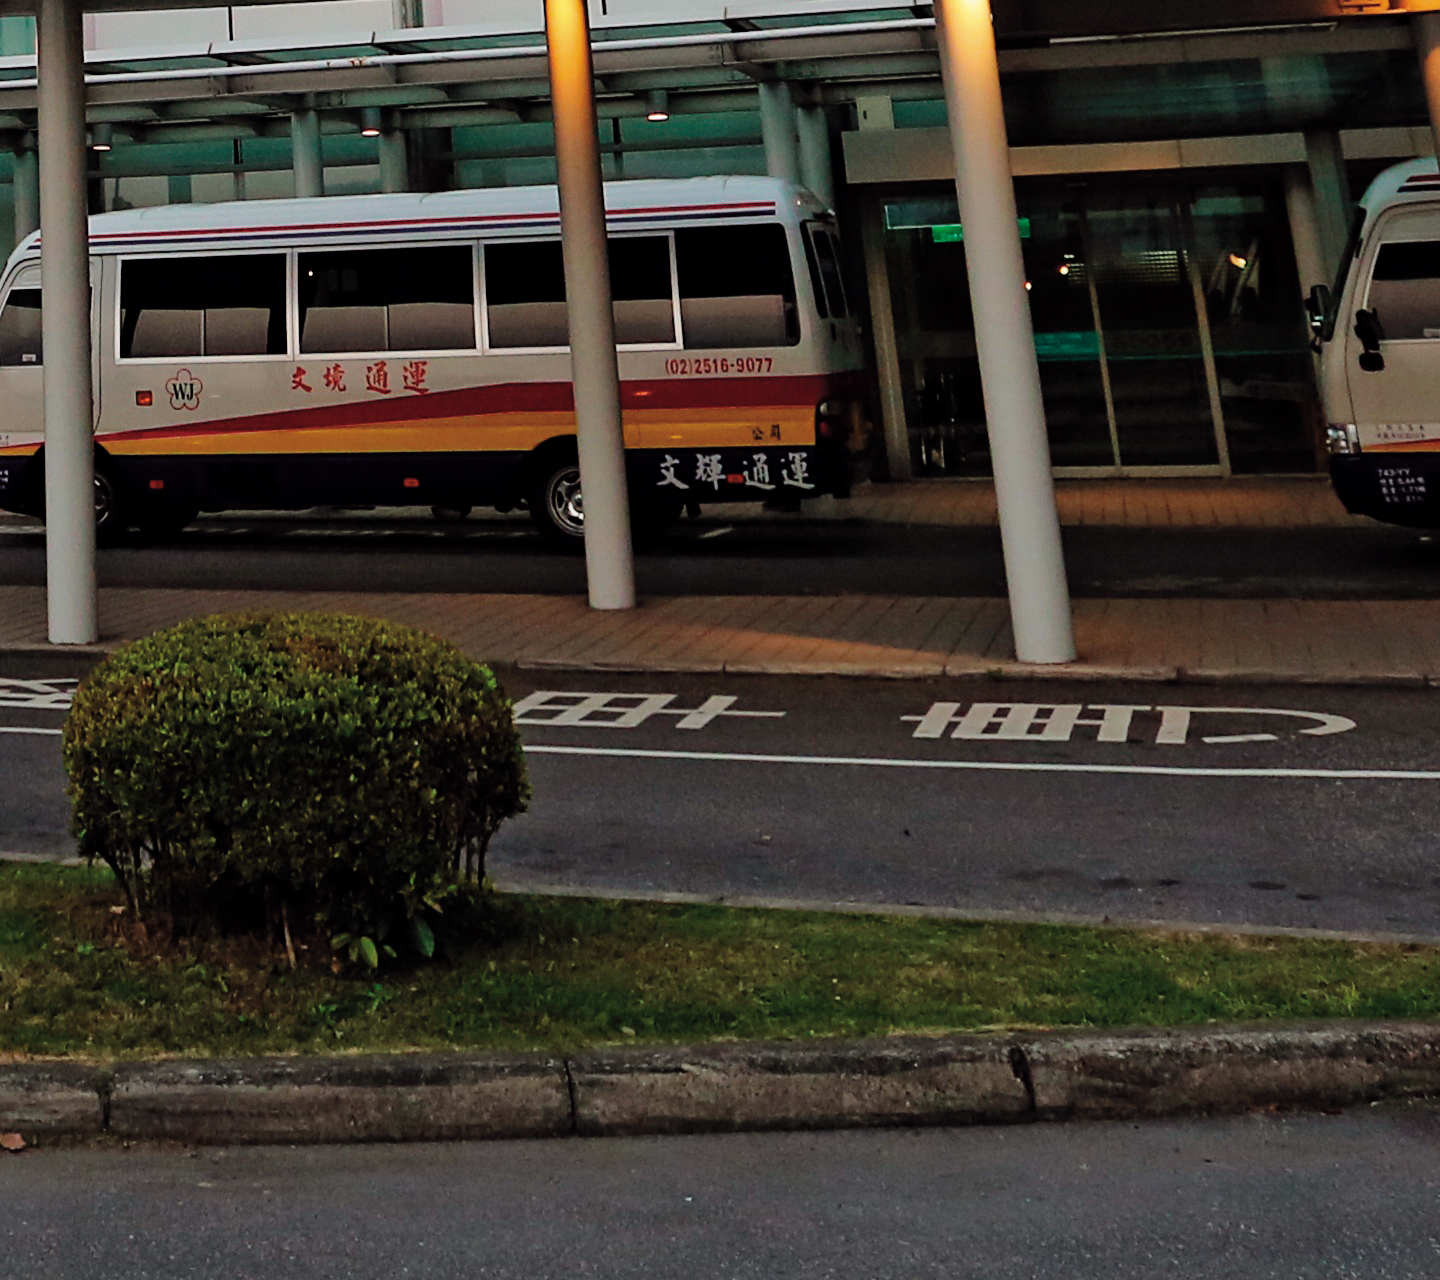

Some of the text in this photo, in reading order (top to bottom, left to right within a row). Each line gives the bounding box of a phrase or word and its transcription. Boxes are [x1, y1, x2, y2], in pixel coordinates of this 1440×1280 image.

[290, 359, 431, 395] 文境通運
[665, 357, 773, 375] (02)2516-9077
[171, 382, 195, 401] WJ
[656, 451, 816, 491] 文輝通運
